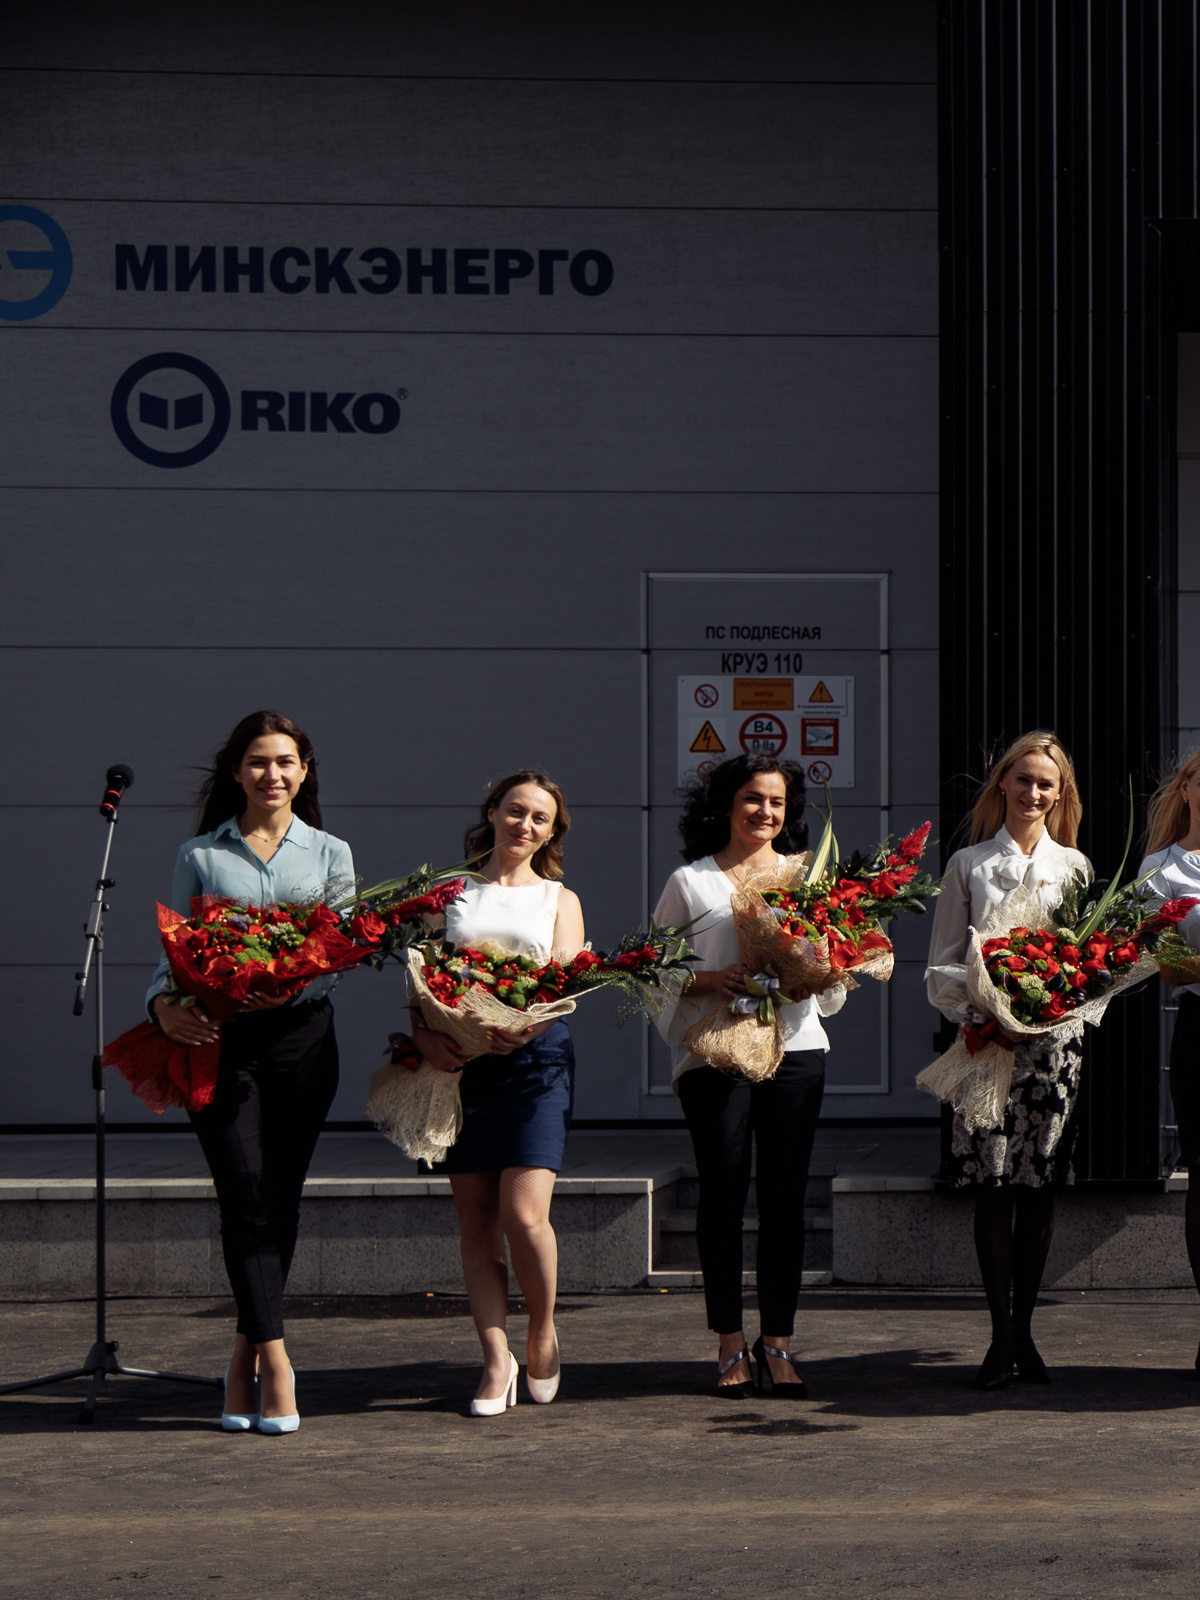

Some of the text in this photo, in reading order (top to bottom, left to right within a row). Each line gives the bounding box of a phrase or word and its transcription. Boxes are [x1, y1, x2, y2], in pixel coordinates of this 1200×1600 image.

[115, 243, 614, 297] МИНСКЭНЕРГО
[706, 626, 821, 641] ПС ПОДЛЕСНАЯ
[721, 653, 803, 673] КРУЭ 110
